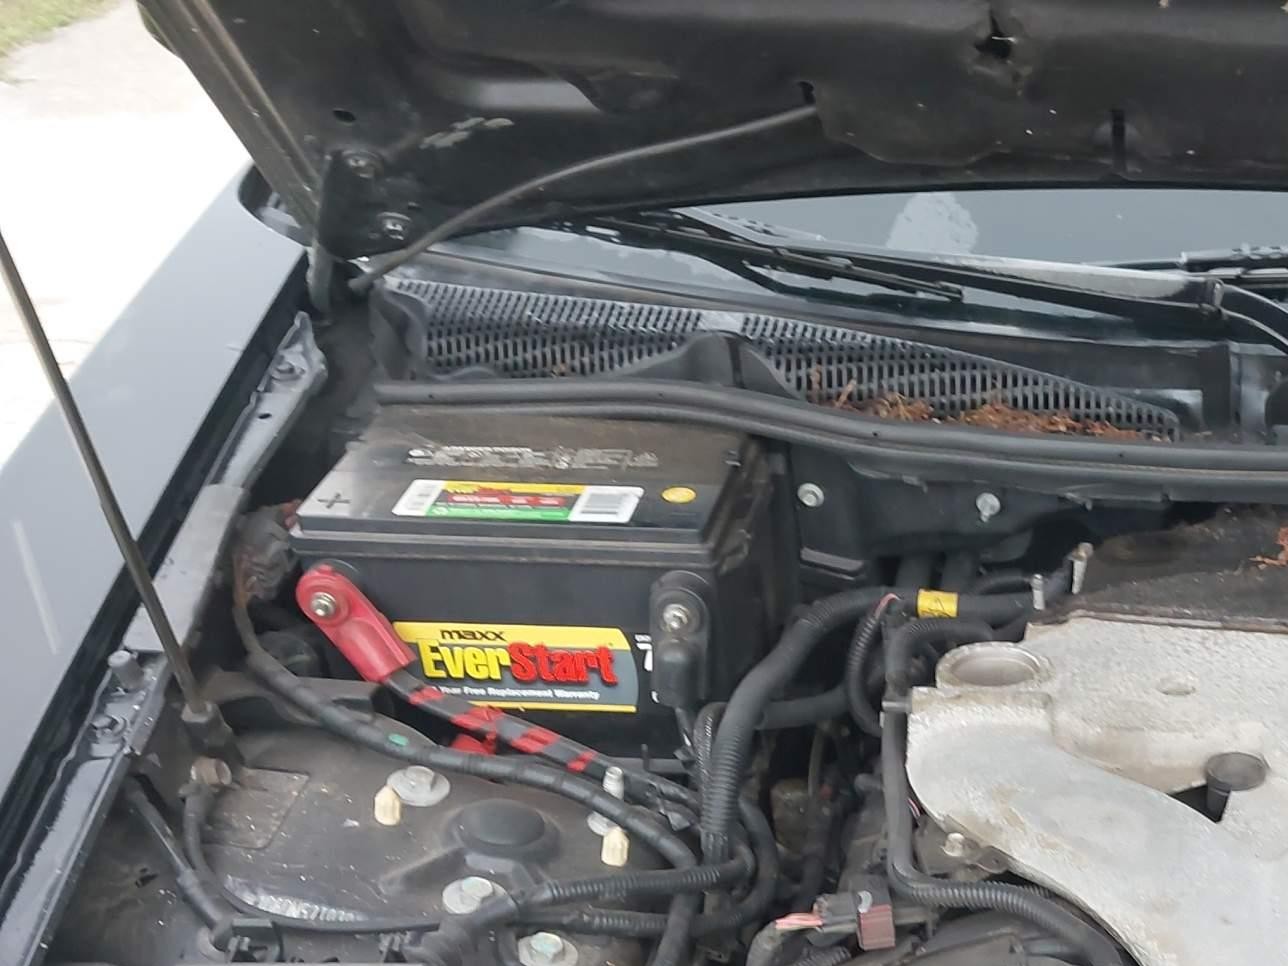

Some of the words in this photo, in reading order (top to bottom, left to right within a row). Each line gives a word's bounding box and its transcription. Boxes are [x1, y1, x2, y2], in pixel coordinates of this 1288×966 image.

[440, 630, 506, 641] maxx
[416, 638, 619, 687] EverStart
[463, 686, 487, 697] Free
[488, 686, 553, 699] Replacement
[554, 688, 600, 701] Warranty
